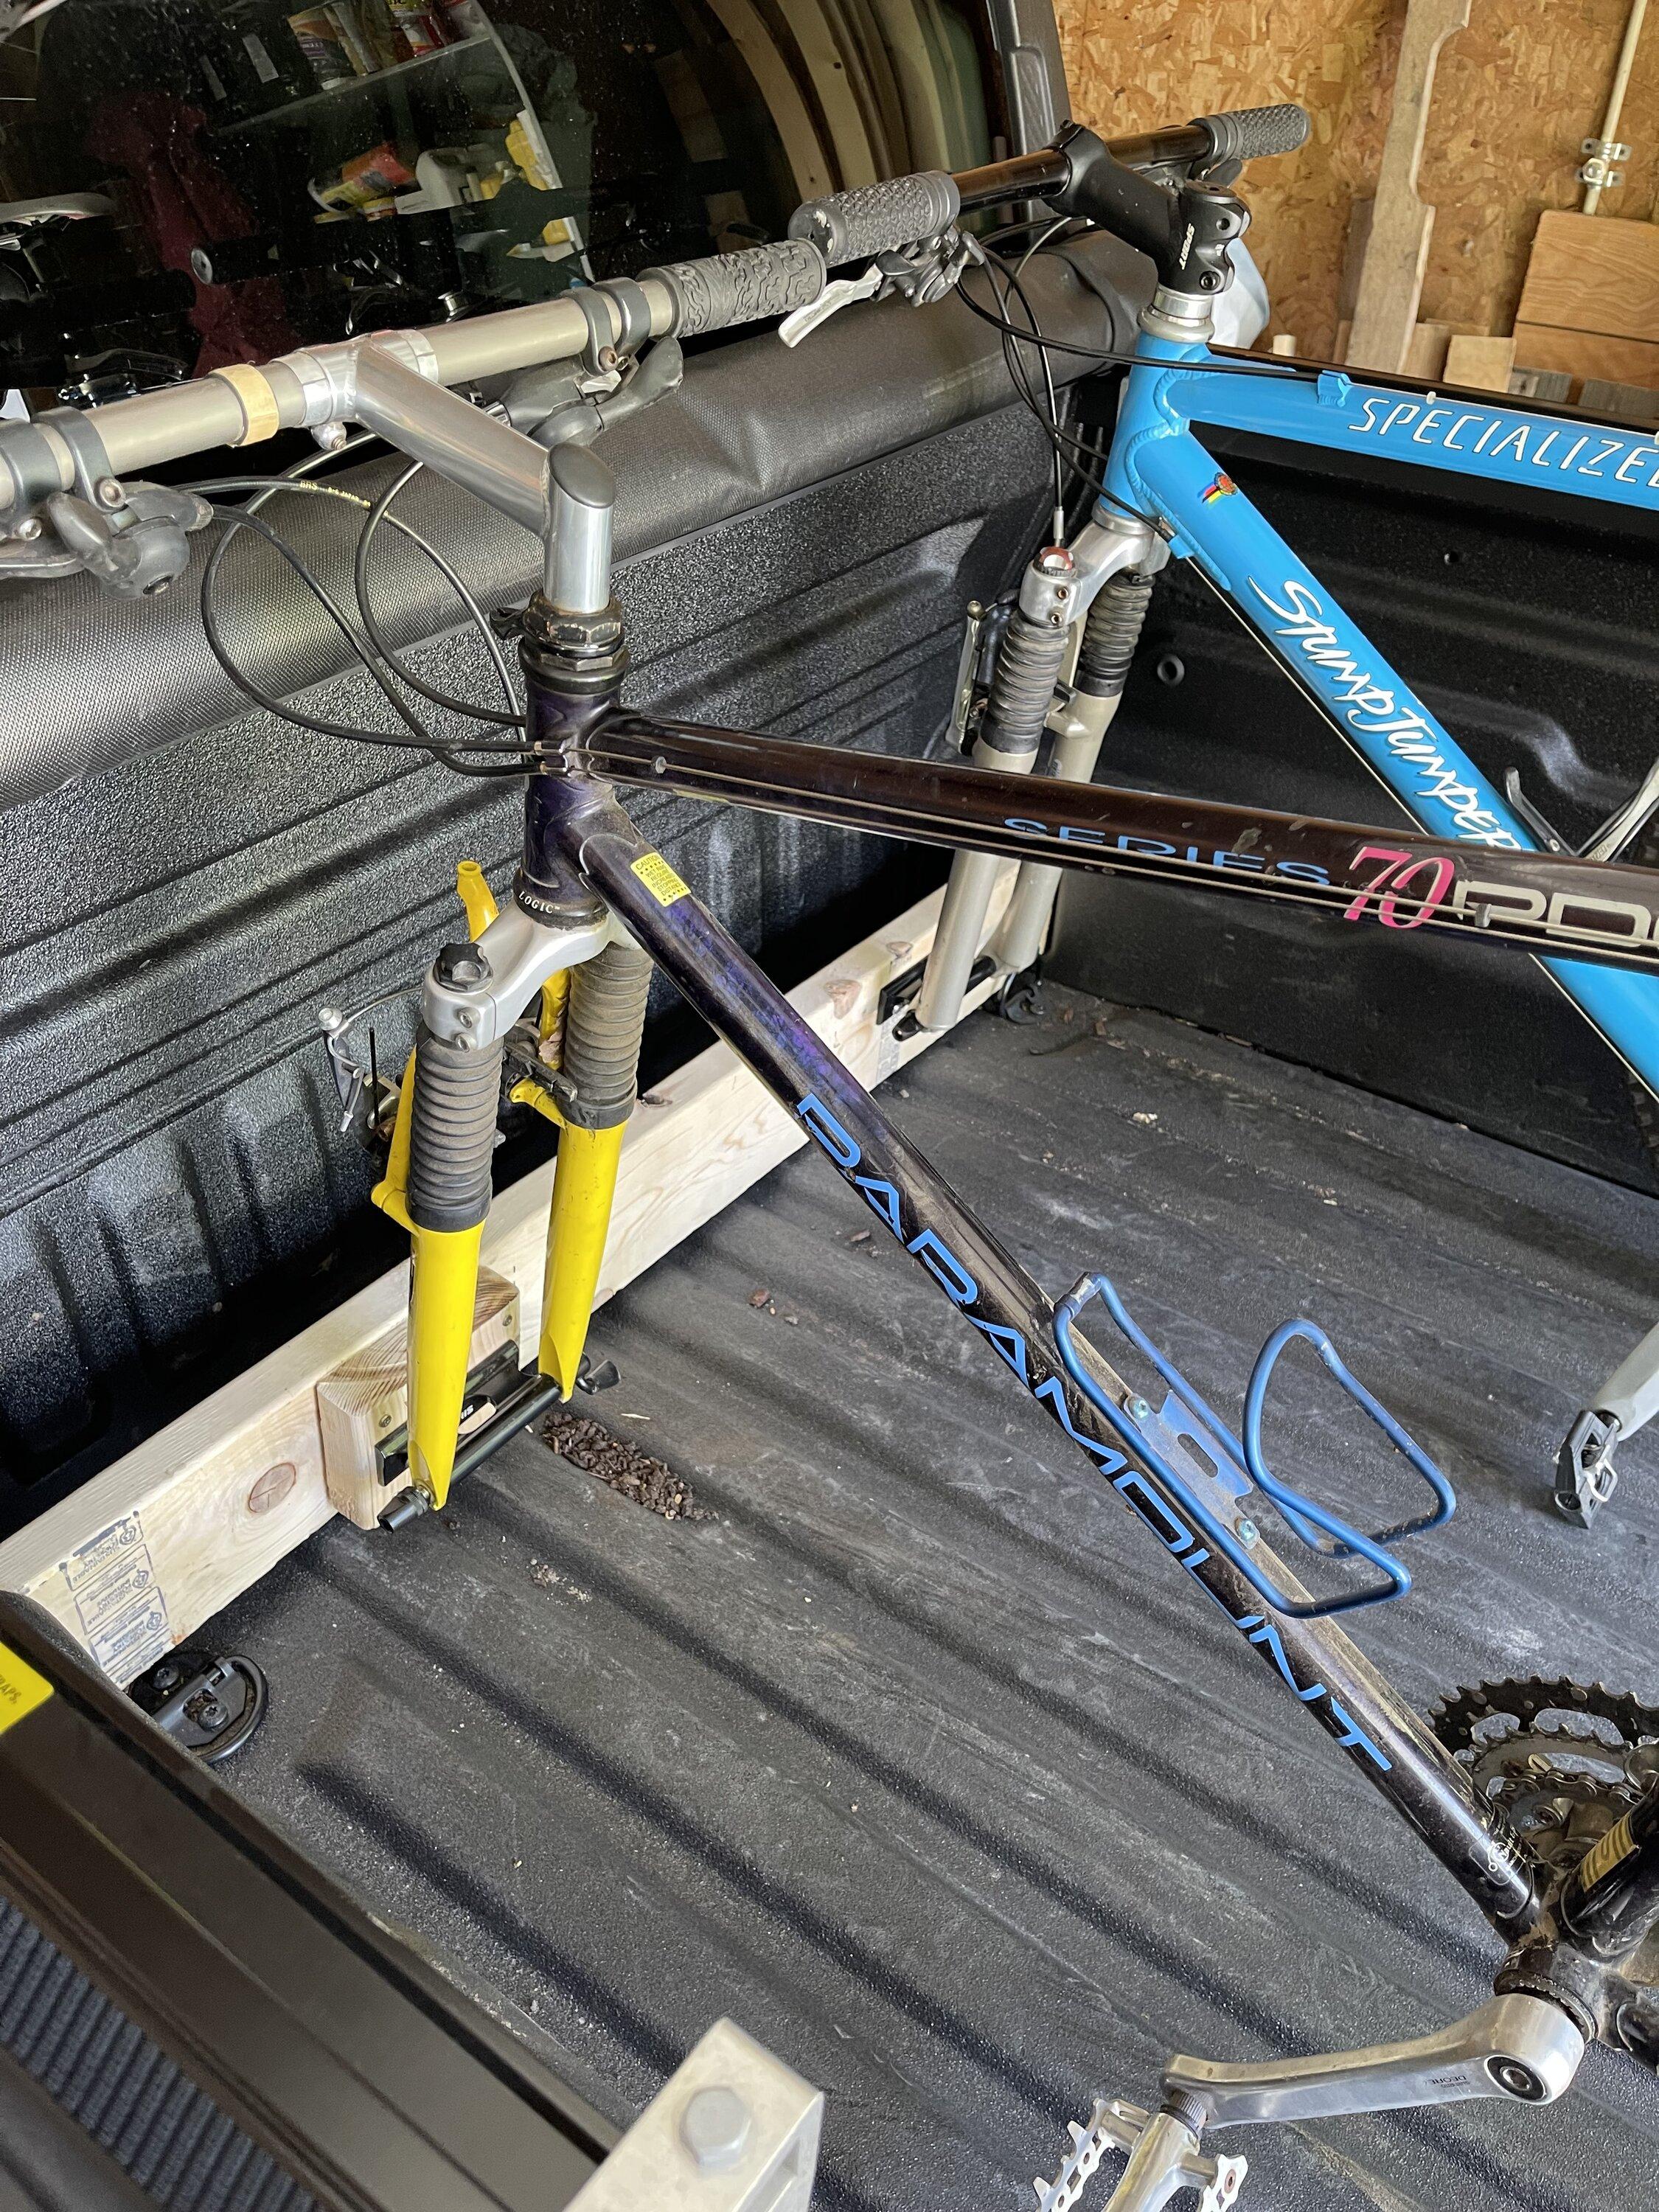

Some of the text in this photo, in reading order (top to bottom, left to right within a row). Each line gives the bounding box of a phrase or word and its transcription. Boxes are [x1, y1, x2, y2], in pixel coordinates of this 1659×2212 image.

[1179, 223, 1194, 270] SPORT
[518, 891, 554, 914] LOGIC
[1004, 818, 1455, 929] SERIES 70
[1452, 880, 1659, 948] PD
[796, 1092, 1393, 1771] PARAMOUNT
